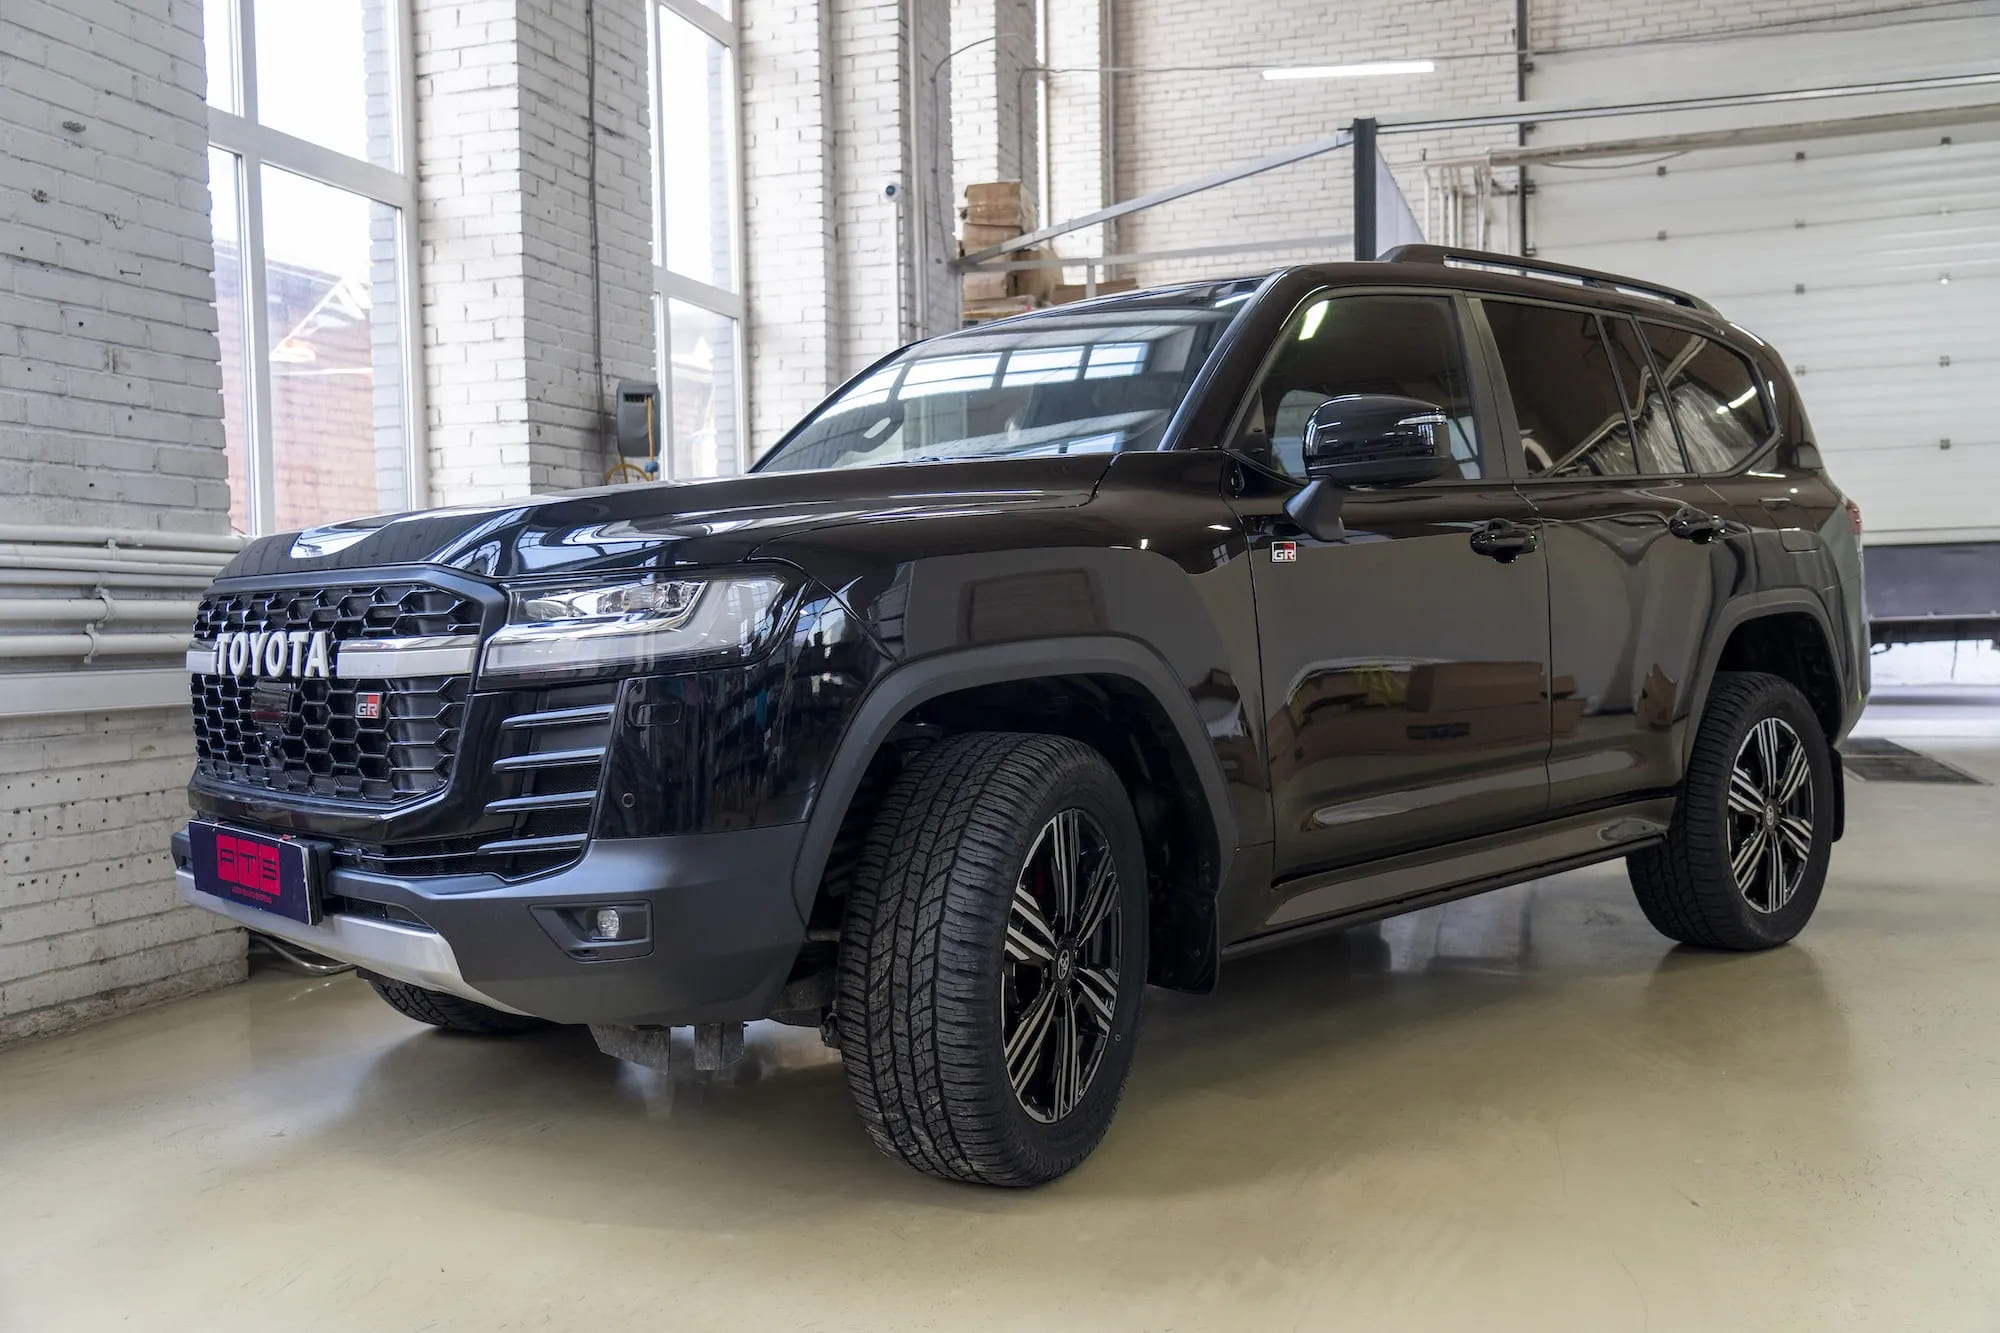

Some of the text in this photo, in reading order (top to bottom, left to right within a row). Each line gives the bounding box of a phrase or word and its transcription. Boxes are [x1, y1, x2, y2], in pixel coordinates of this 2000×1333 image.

[1274, 549, 1295, 561] GR
[216, 631, 330, 677] TOYOTA
[357, 702, 379, 717] GR
